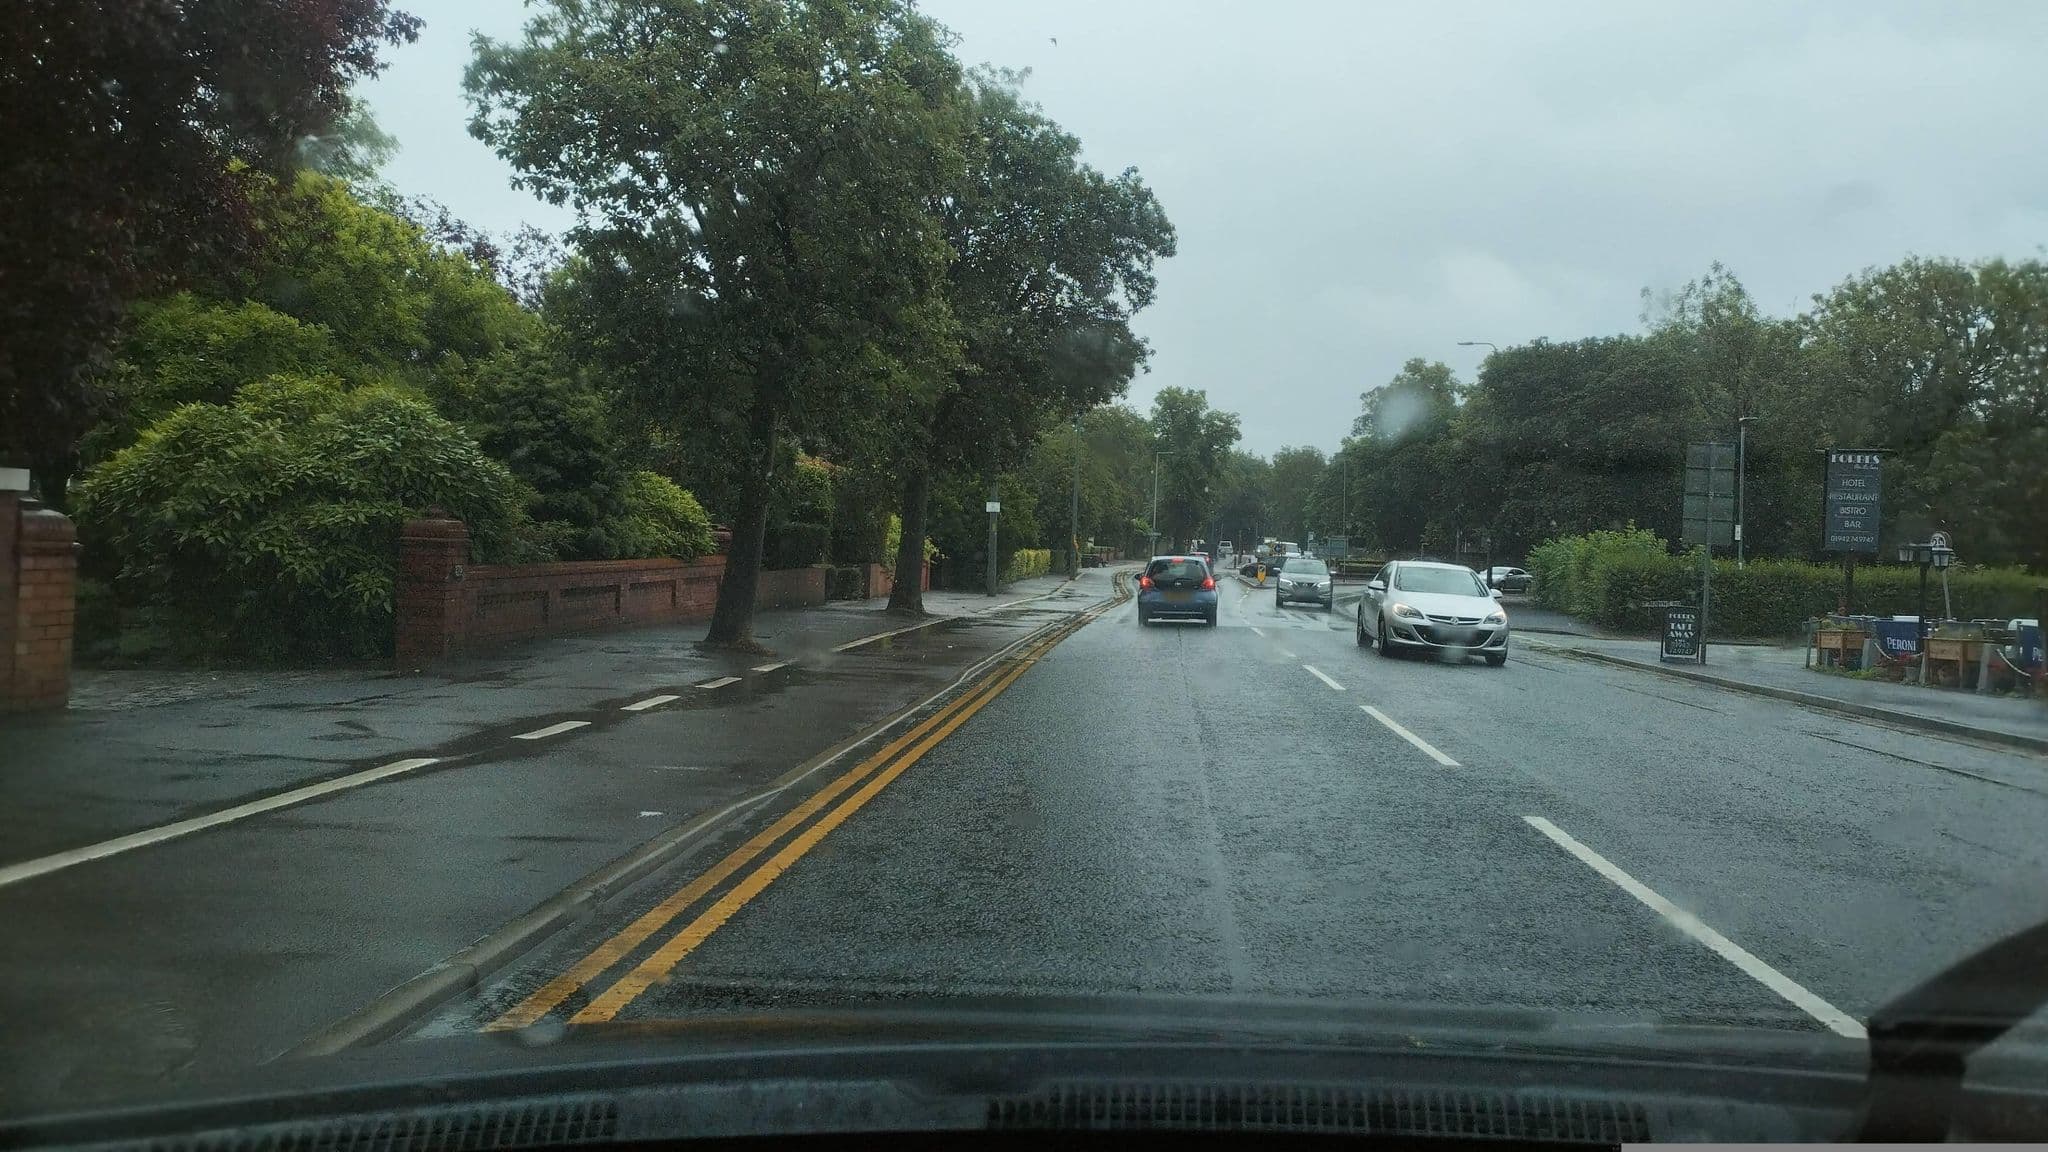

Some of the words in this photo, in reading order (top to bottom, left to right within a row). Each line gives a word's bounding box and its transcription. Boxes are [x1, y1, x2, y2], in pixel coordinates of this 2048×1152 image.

[1841, 479, 1866, 487] HOTEL
[1829, 493, 1879, 501] RESTAURANT
[1840, 506, 1867, 515] BISTRO
[1844, 520, 1861, 528] BAR
[1670, 622, 1692, 630] TAKE
[1886, 636, 1916, 651] PERONI
